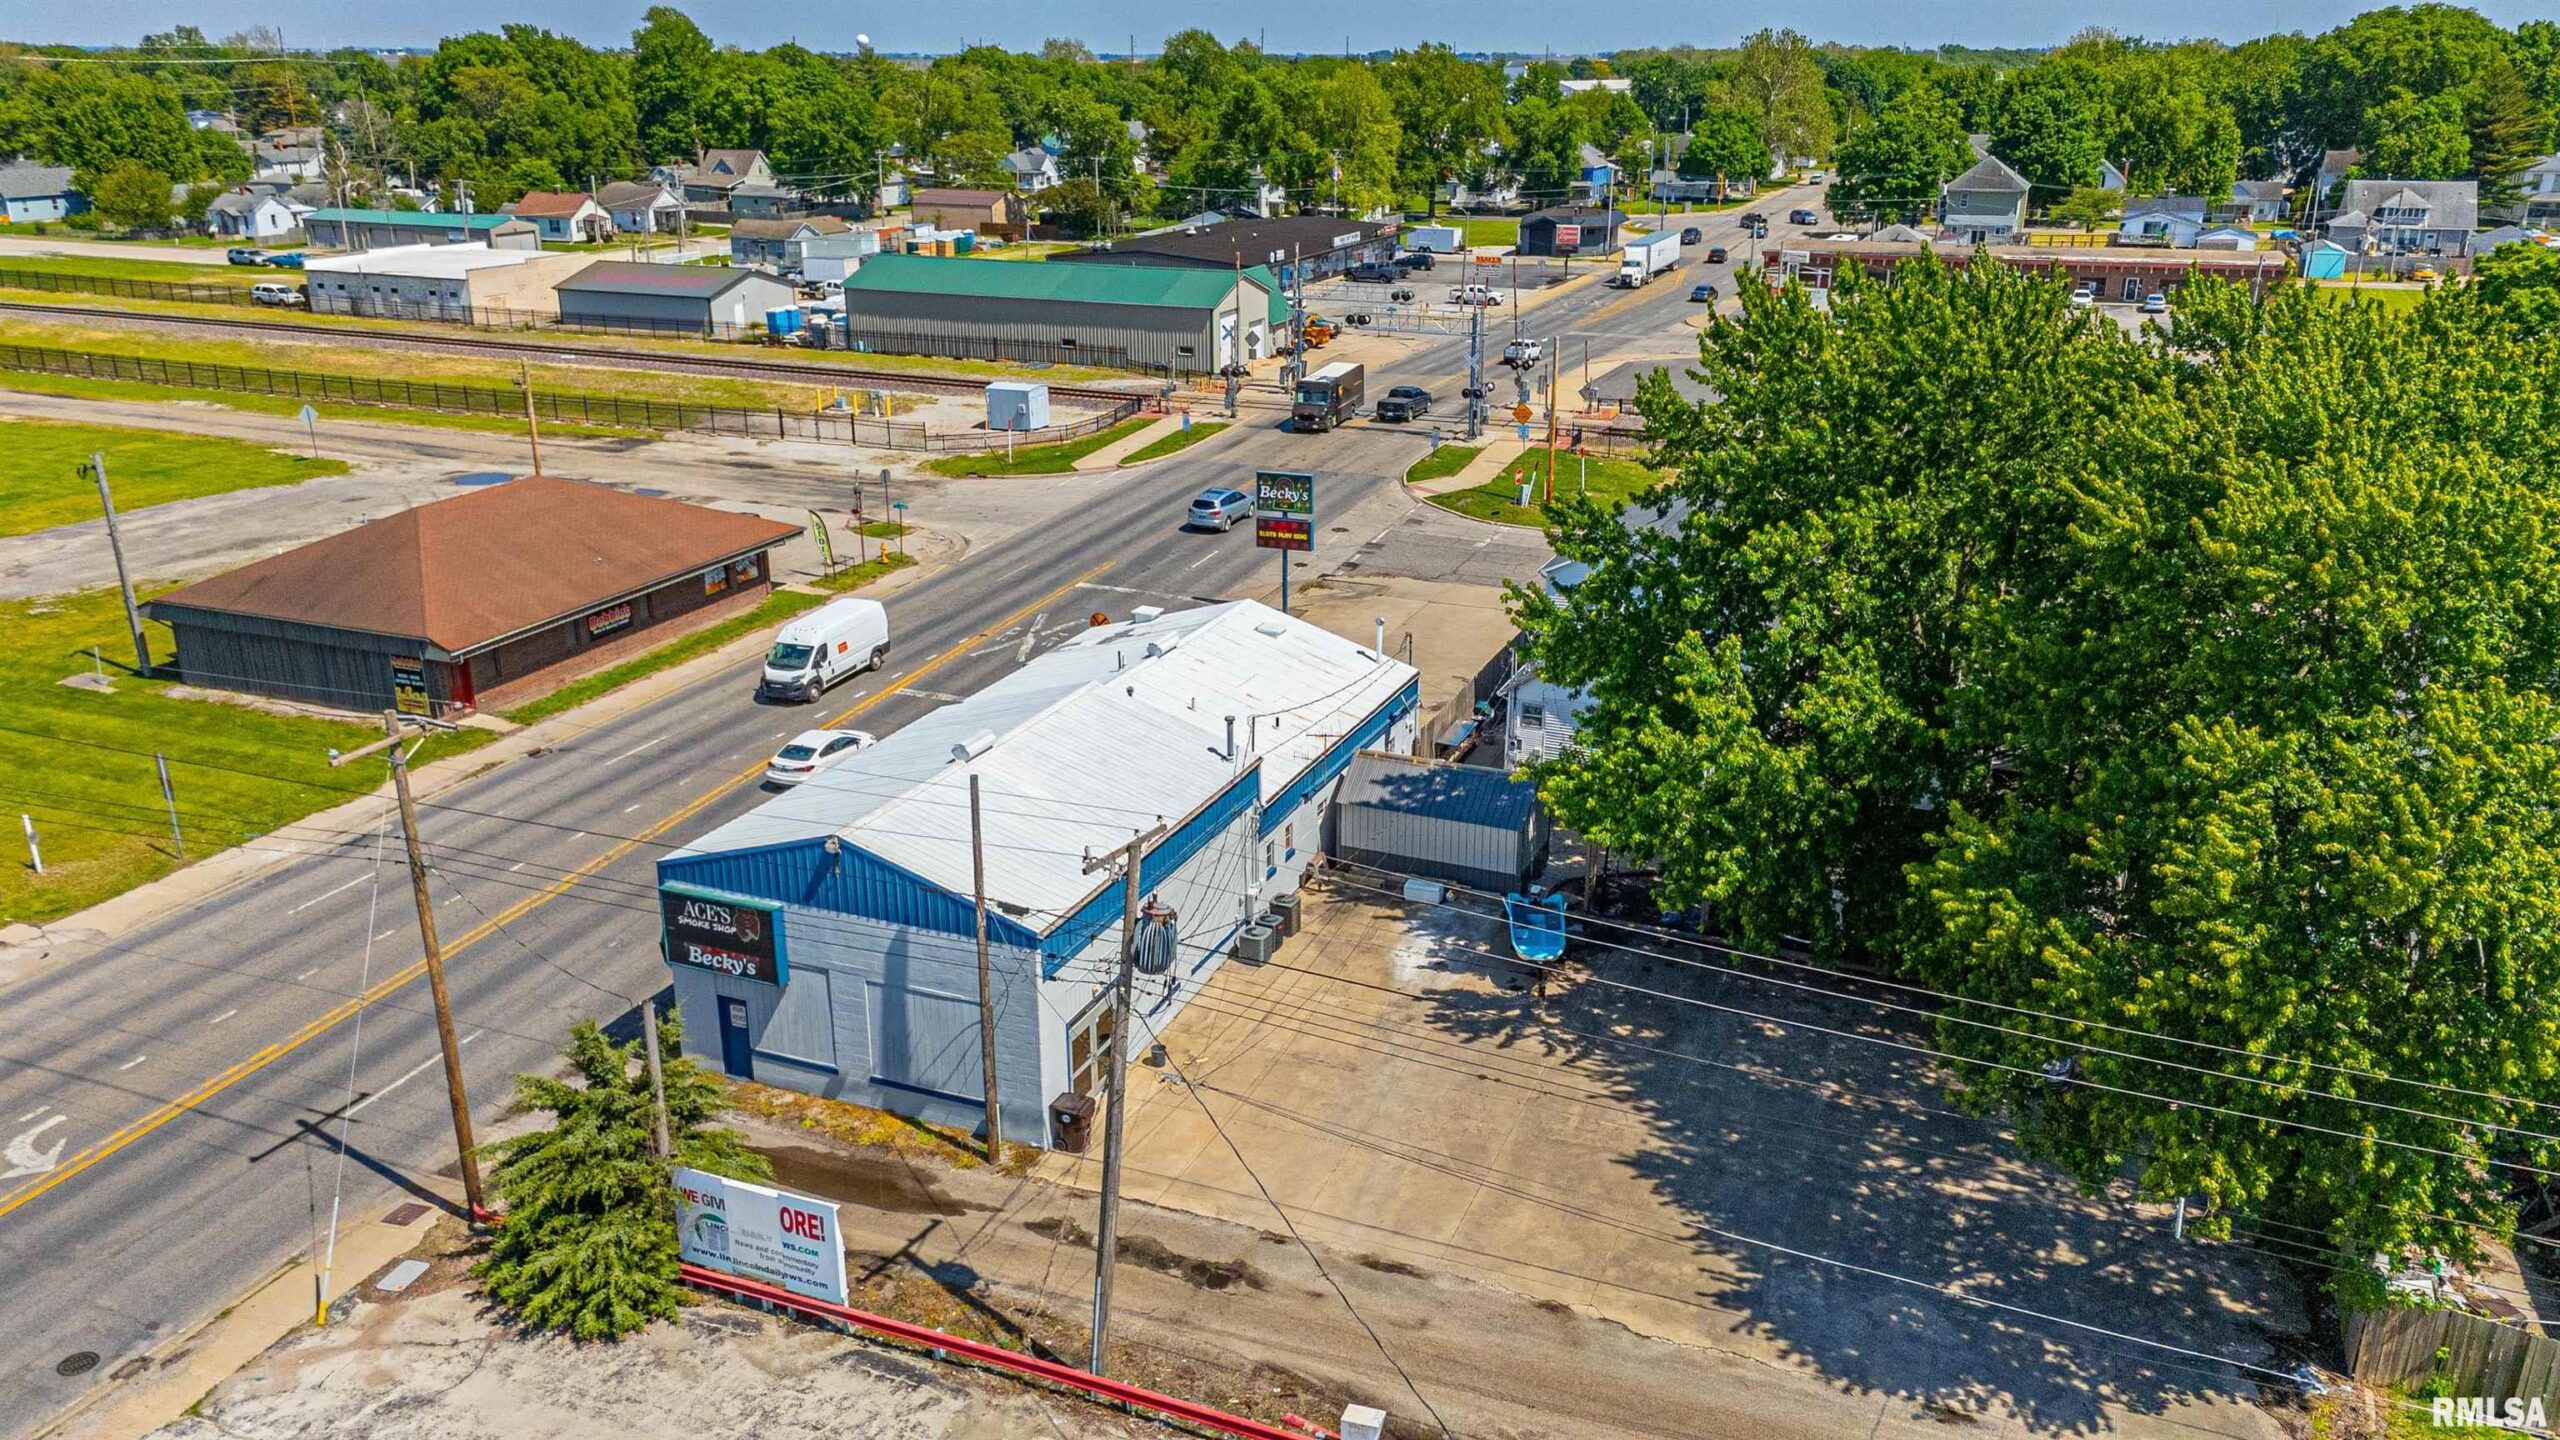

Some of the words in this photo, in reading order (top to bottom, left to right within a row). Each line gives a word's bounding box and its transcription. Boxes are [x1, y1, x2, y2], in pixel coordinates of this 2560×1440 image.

[1260, 485, 1309, 502] Becky's
[684, 900, 731, 924] ACE'S
[677, 915, 711, 930] SMOKE
[712, 923, 737, 934] SHOP
[688, 945, 757, 976] Becky's
[780, 1206, 825, 1242] ORE!
[735, 1240, 753, 1250] News
[755, 1244, 768, 1252] and
[760, 1252, 776, 1262] from
